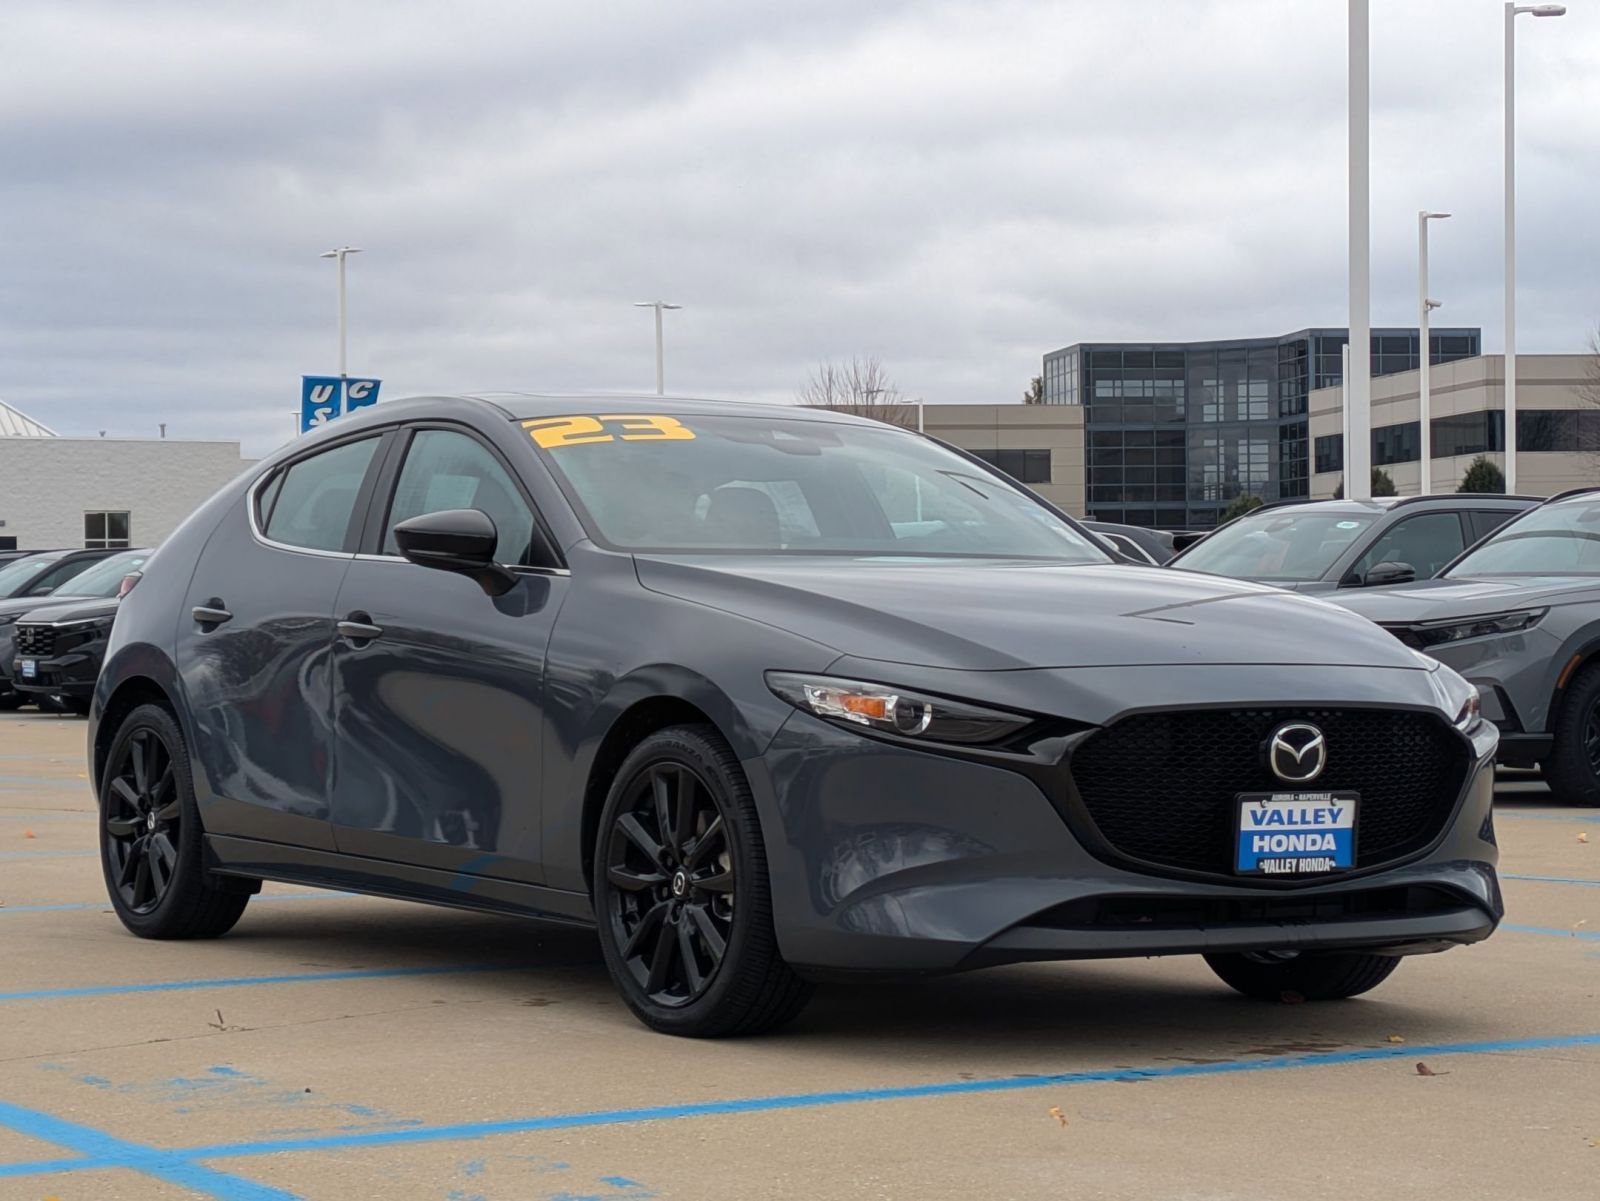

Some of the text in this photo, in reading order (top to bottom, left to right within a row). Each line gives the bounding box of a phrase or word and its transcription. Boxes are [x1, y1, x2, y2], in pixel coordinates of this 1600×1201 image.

[519, 414, 697, 449] 23
[1250, 807, 1343, 826] VALLEY
[1252, 833, 1336, 852] HONDA
[1264, 858, 1331, 874] VALLEY HONDA
